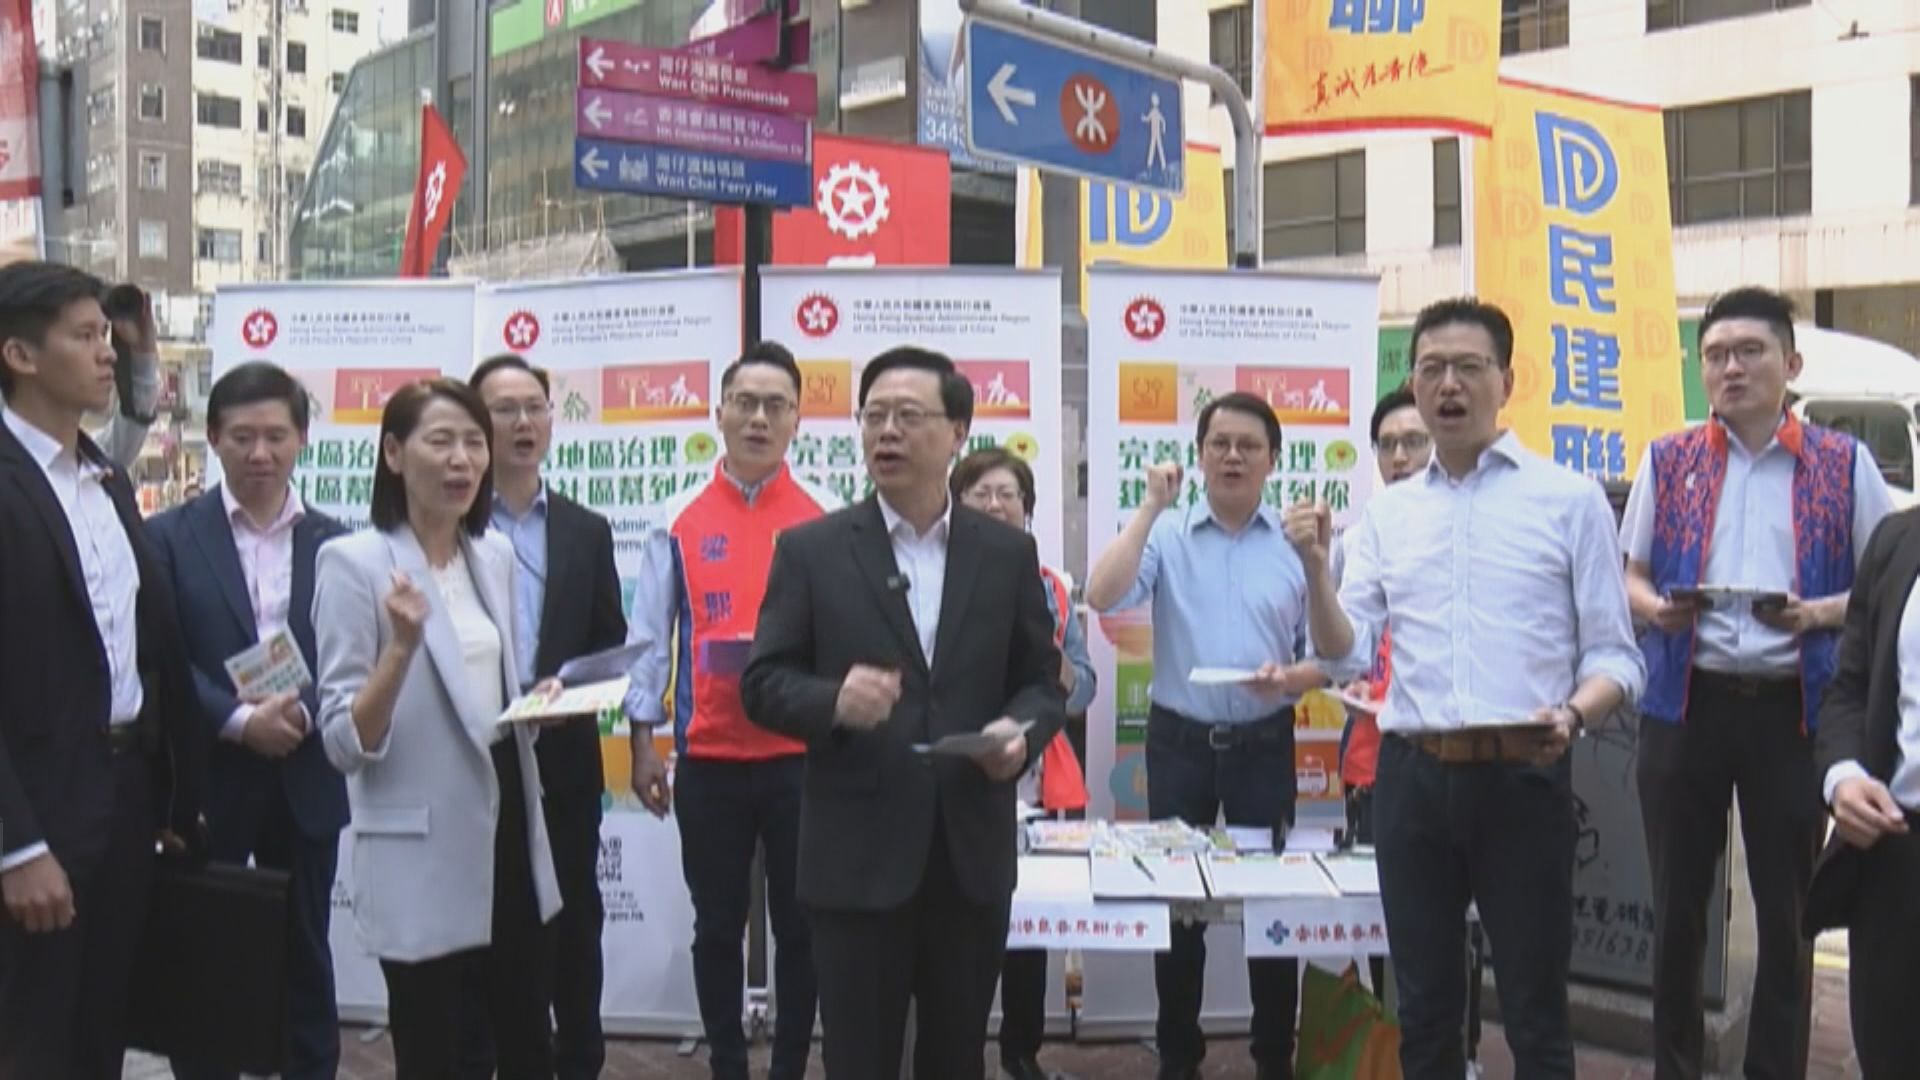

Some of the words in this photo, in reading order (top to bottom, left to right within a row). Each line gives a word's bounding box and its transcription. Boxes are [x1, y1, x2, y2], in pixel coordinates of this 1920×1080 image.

[658, 74, 687, 90] Wan
[690, 79, 719, 95] Chai
[723, 83, 790, 107] Promenade
[656, 173, 684, 189] Wan
[688, 176, 716, 192] Chai
[720, 178, 752, 198] Ferry
[755, 183, 778, 199] Pier
[543, 435, 677, 470] 地區治理
[1010, 915, 1149, 938] 港島各界聯合會
